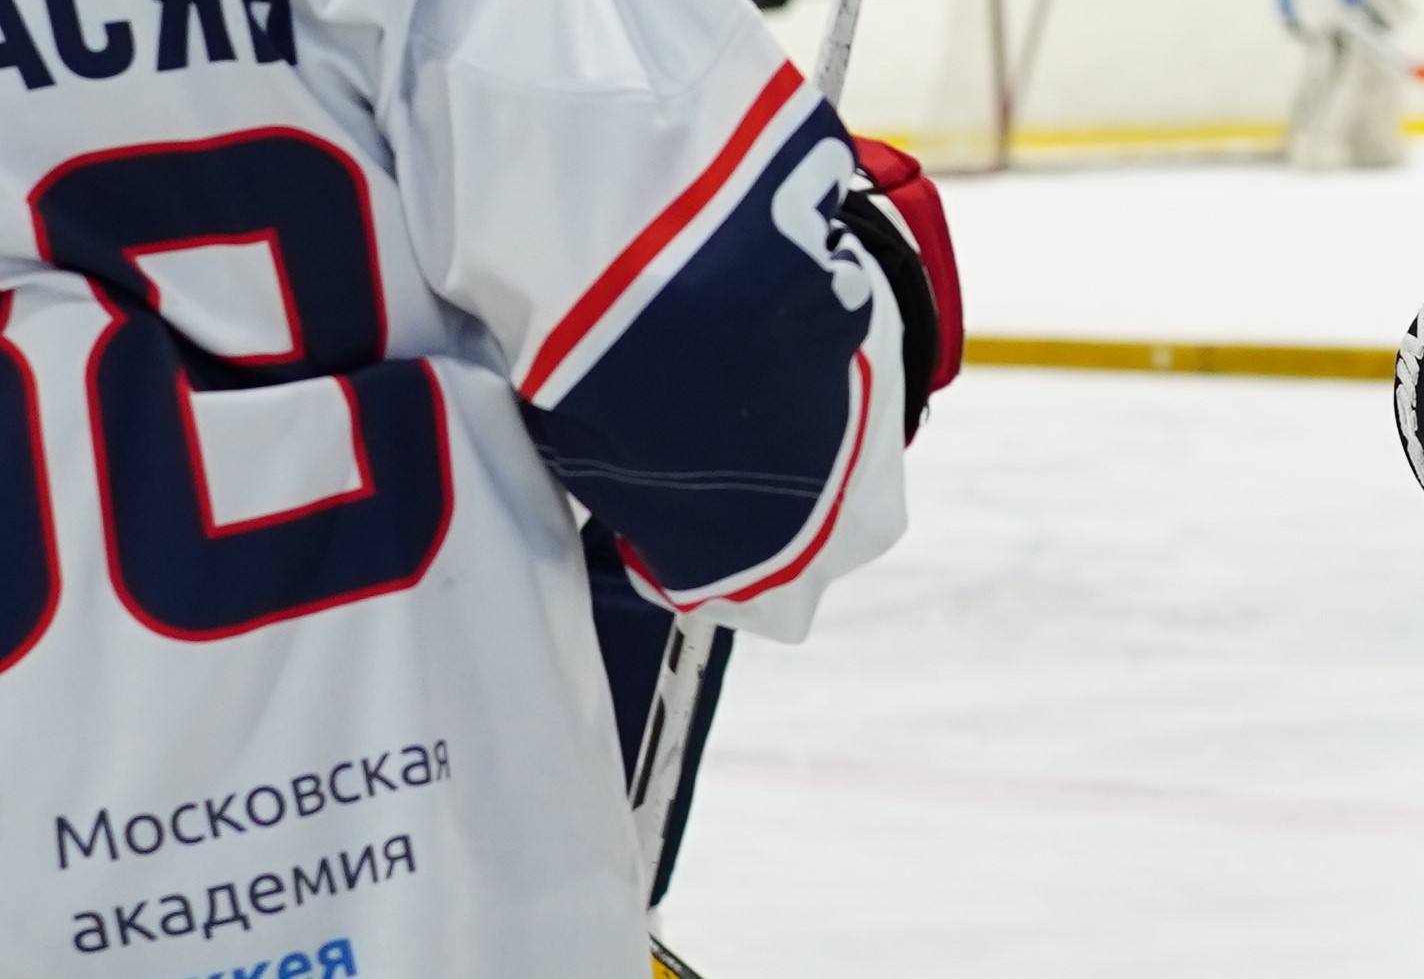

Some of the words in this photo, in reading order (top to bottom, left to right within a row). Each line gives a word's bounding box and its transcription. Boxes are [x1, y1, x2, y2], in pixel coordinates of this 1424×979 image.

[0, 125, 455, 673] 8
[54, 739, 452, 870] Московская
[72, 833, 418, 954] академия
